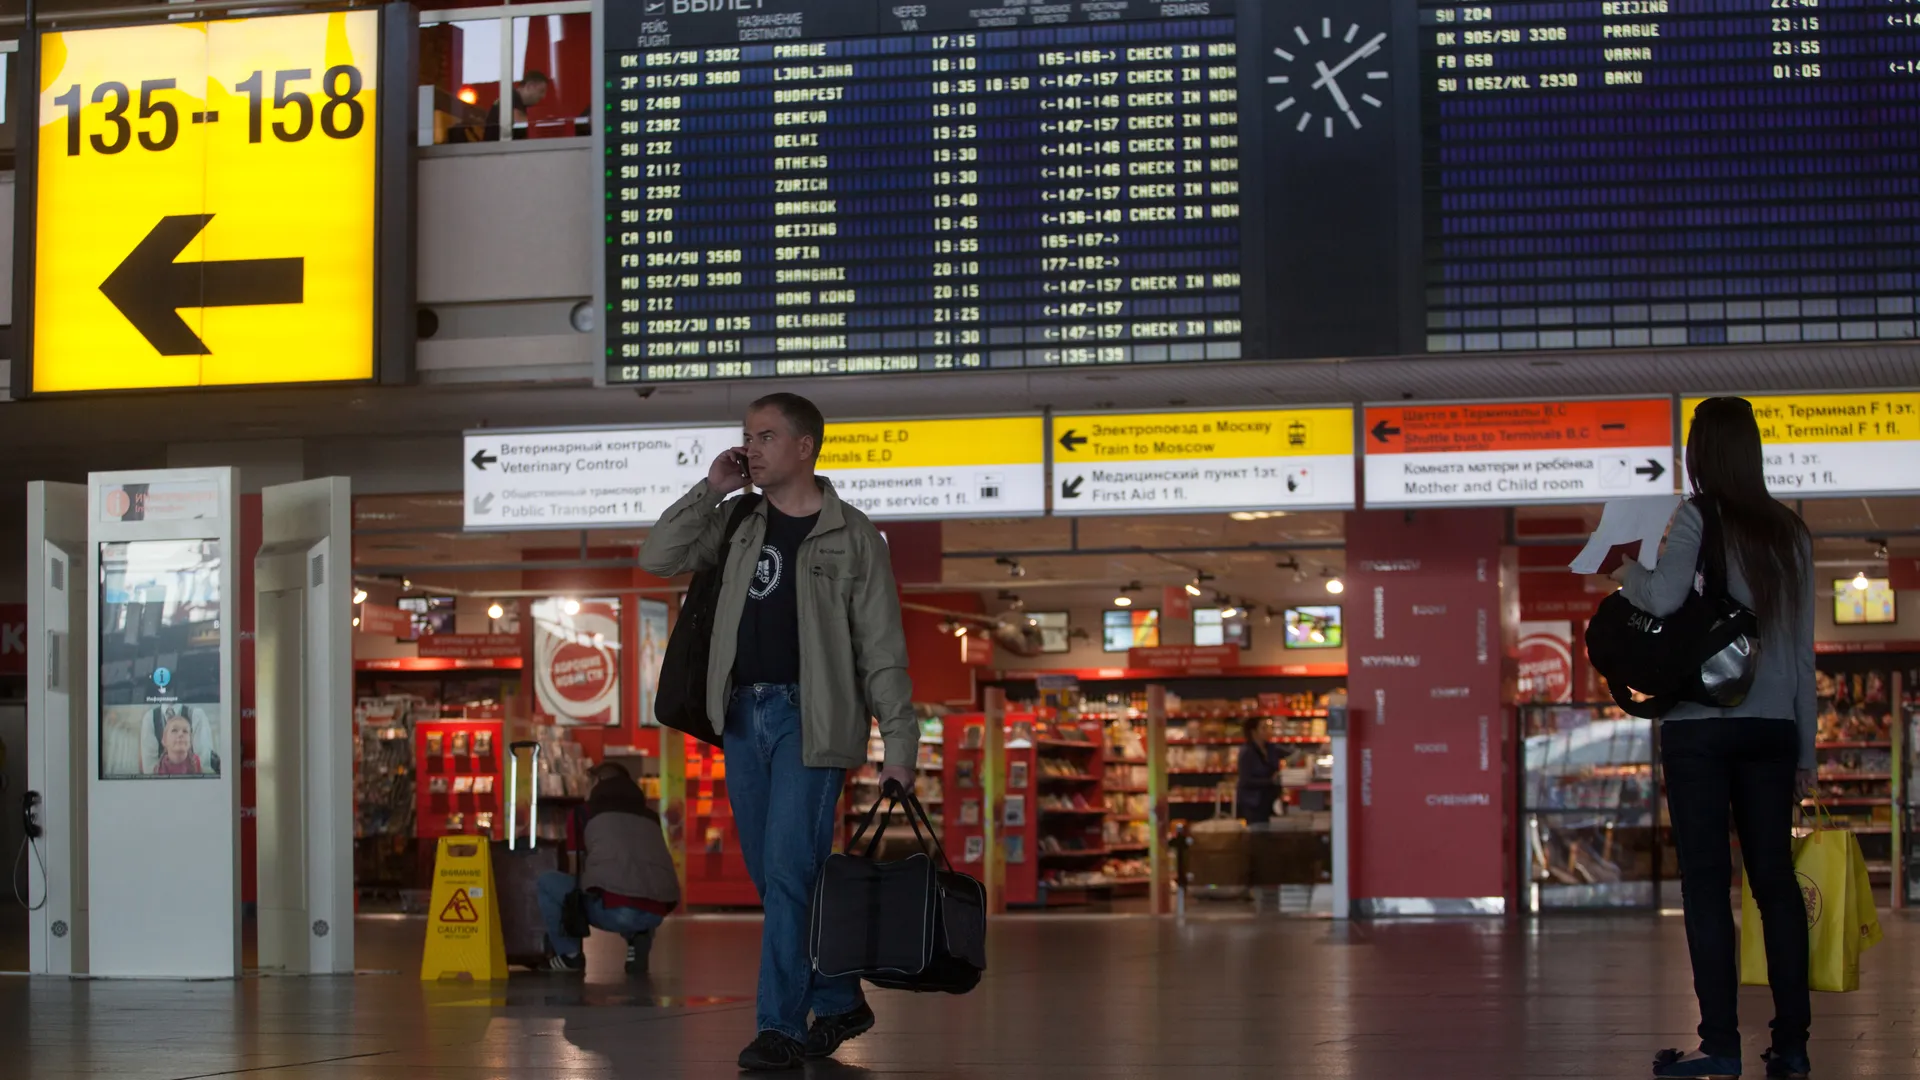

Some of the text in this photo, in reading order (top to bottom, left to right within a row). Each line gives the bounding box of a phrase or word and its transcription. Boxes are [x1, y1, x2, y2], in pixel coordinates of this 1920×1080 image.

[892, 5, 927, 19] ЧЕРЕЗ
[1160, 2, 1210, 17] REMARKS
[1435, 0, 1669, 23] SU 204 BEIJING
[739, 26, 801, 41] DESTINATION
[901, 19, 918, 31] VIA
[1436, 16, 1819, 46] OK 905/SU 3306 PRAGUE 23:15
[637, 33, 671, 48] FLIGHT
[620, 34, 976, 68] OK PRAGUE 17:15
[1464, 53, 1493, 68] 658
[1603, 47, 1652, 62] VARNA
[1772, 40, 1821, 55] 23:55
[621, 76, 639, 90] JP
[645, 73, 698, 89] 915/SU
[773, 64, 853, 81] LJUBLJANA
[932, 56, 976, 72] 18:10
[1126, 46, 1173, 61] CHECK
[1181, 45, 1200, 59] IN
[1208, 43, 1236, 57] NOW
[1437, 78, 1457, 92] SU
[1539, 72, 1578, 88] 2930
[1604, 70, 1643, 85] BAKU
[1773, 63, 1821, 79] 01:05
[620, 99, 639, 112] SU
[773, 86, 843, 103] BUDAPEST
[932, 79, 976, 94] 18:35
[985, 76, 1030, 92] 18:50
[620, 121, 639, 134] SU
[774, 110, 827, 126] GENEVA
[933, 102, 977, 117] 19:10
[621, 124, 977, 157] SU 232 DELHI 19:25
[620, 147, 977, 179] SU 2112 ATHENS 19:30
[620, 170, 978, 201] SU 2392 ZURICH 19:30
[621, 192, 978, 223] SU 270 BANGKOK 19:40
[621, 204, 1240, 246] CA 910 BEIJING 19:45 CHECK IN NOW
[775, 246, 820, 261] SOFIA
[935, 238, 979, 253] 19:55
[647, 274, 699, 289] 592/SU
[707, 271, 742, 286] 3900
[775, 267, 845, 283] SHANGHAI
[933, 261, 979, 277] 20:10
[621, 284, 979, 313] SU 212 HONG KONG 20:15
[621, 307, 980, 335] SU BELGRADE 21:25
[622, 320, 1241, 357] SU SHANGHAI 21:30 CHECK IN NOW
[622, 366, 640, 380] CZ
[934, 353, 980, 369] 22:40
[1788, 402, 1880, 419] Терминал F
[1092, 420, 1272, 437] Электропоезд в Москву
[1404, 428, 1561, 444] Shuttle bus to Terminals
[1785, 423, 1854, 438] Terminal
[1858, 422, 1868, 434] F
[1874, 422, 1880, 434] 1
[1886, 421, 1900, 434] fl.
[500, 440, 672, 456] Ветеринарный контроль
[1092, 441, 1215, 456] Train to Moscow
[500, 457, 629, 475] Veterinary Control
[1403, 463, 1465, 475] Комната
[1467, 462, 1520, 474] матери
[1523, 461, 1532, 470] и
[850, 477, 923, 491] хранения
[1091, 468, 1248, 483] Медицинский пункт
[1823, 471, 1837, 484] fl.
[1093, 487, 1188, 501] First Aid 1 fl.
[1404, 478, 1583, 494] Mother and Child room
[502, 505, 544, 517] Public
[550, 502, 617, 516] Transport
[634, 501, 645, 513] fl.
[886, 495, 940, 507] service
[437, 925, 479, 935] CAUTION
